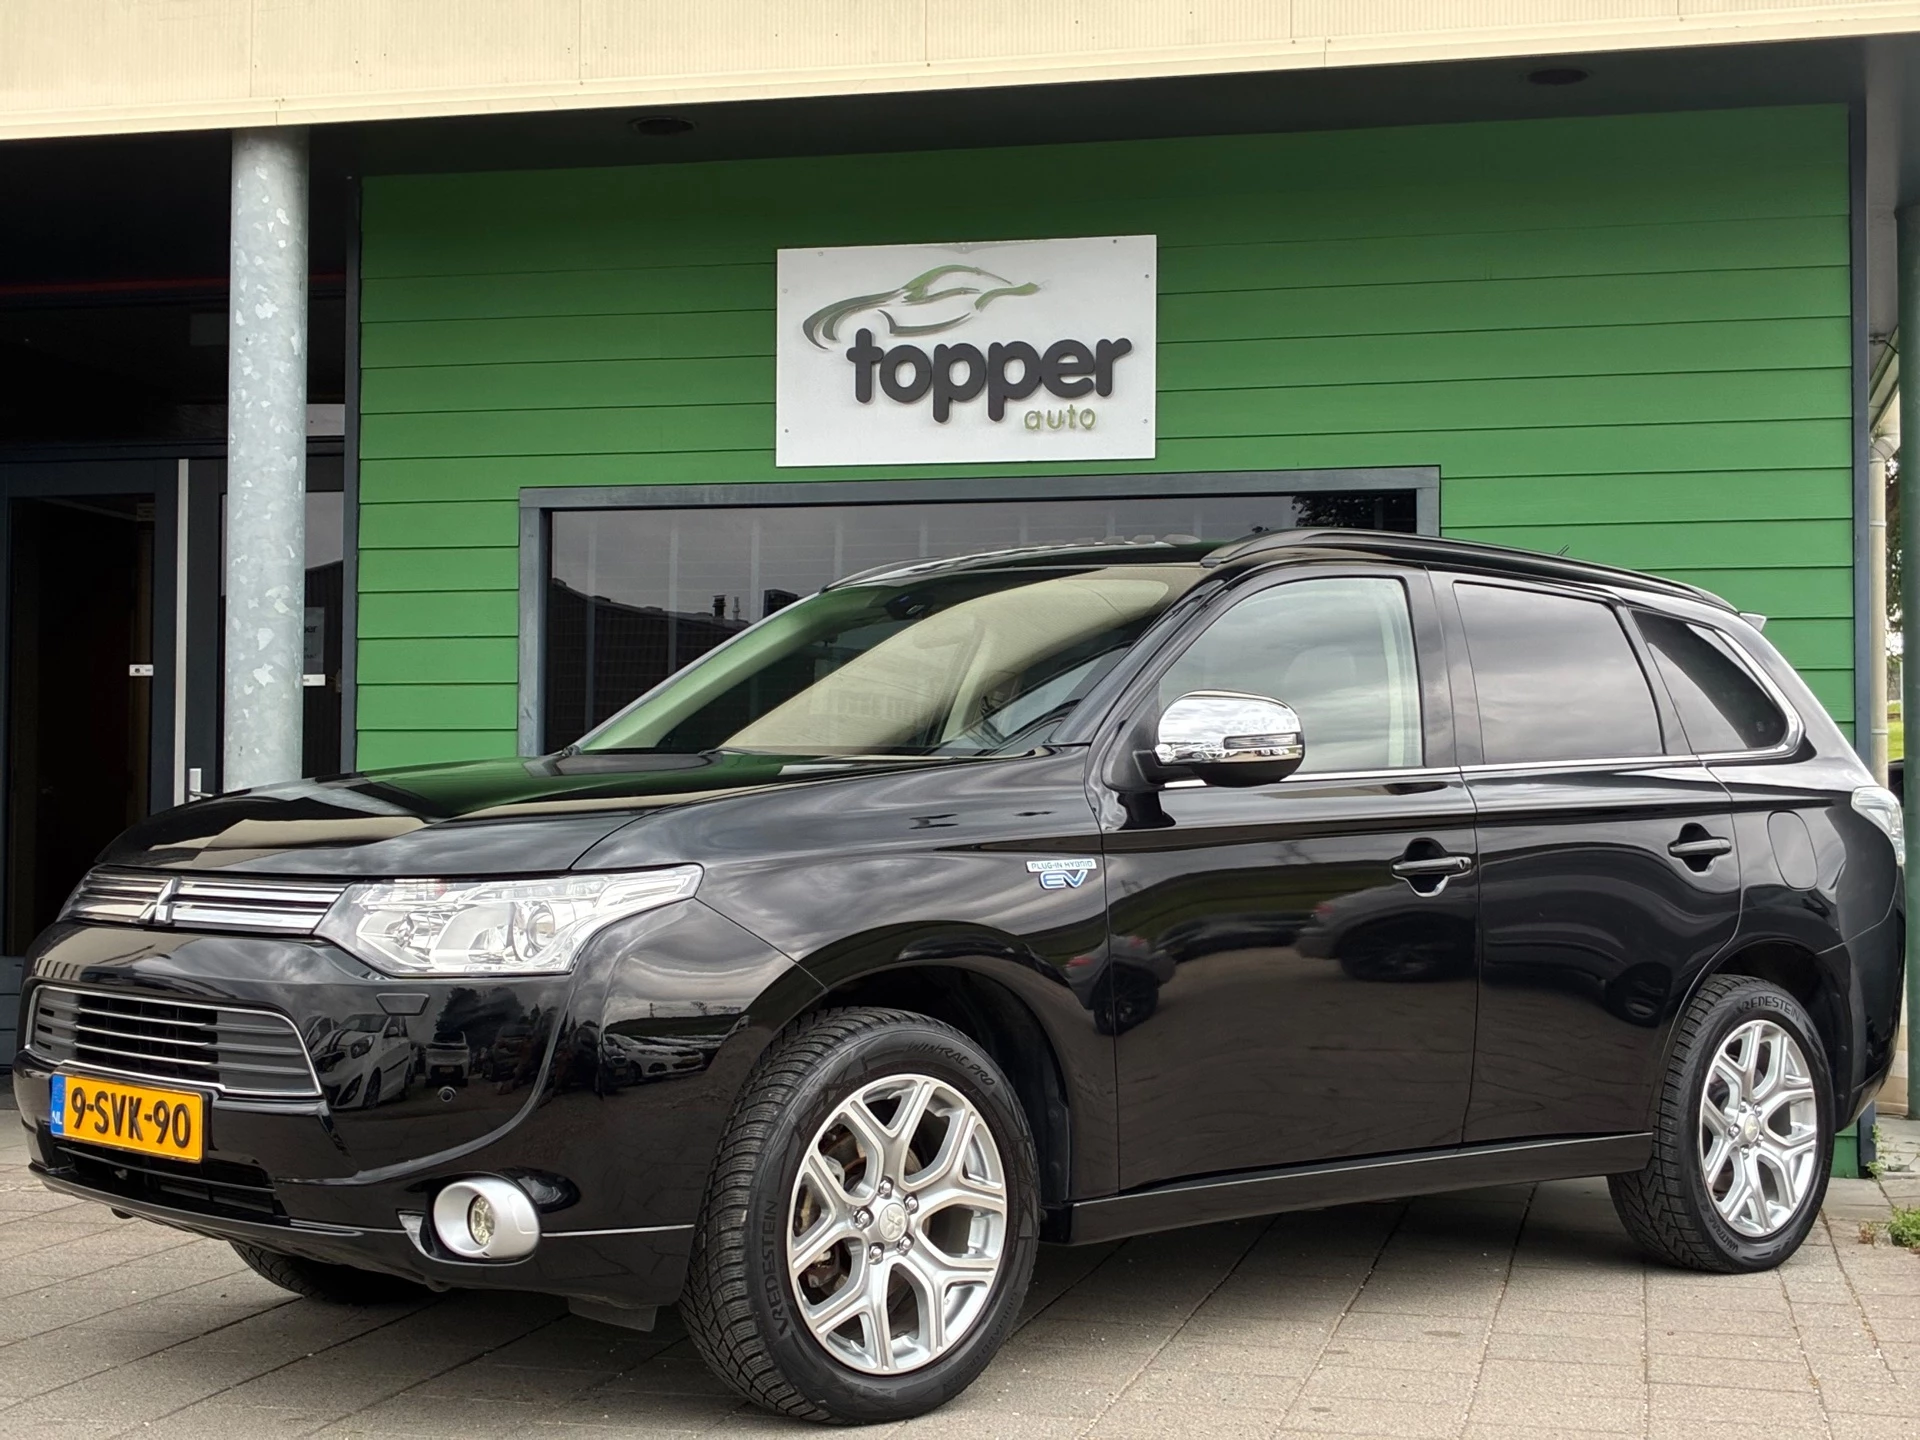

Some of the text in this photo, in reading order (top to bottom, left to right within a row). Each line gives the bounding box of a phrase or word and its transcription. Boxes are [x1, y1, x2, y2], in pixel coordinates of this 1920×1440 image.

[846, 328, 1132, 423] topper
[1024, 404, 1096, 430] auto
[1031, 860, 1093, 870] PLUG-IN HYBRID
[1041, 870, 1087, 888] EV
[904, 1041, 995, 1086] WINTRAC PRO
[51, 1110, 63, 1125] NL
[71, 1087, 191, 1148] 9-SVK-90
[762, 1200, 788, 1336] VREDESTEIN
